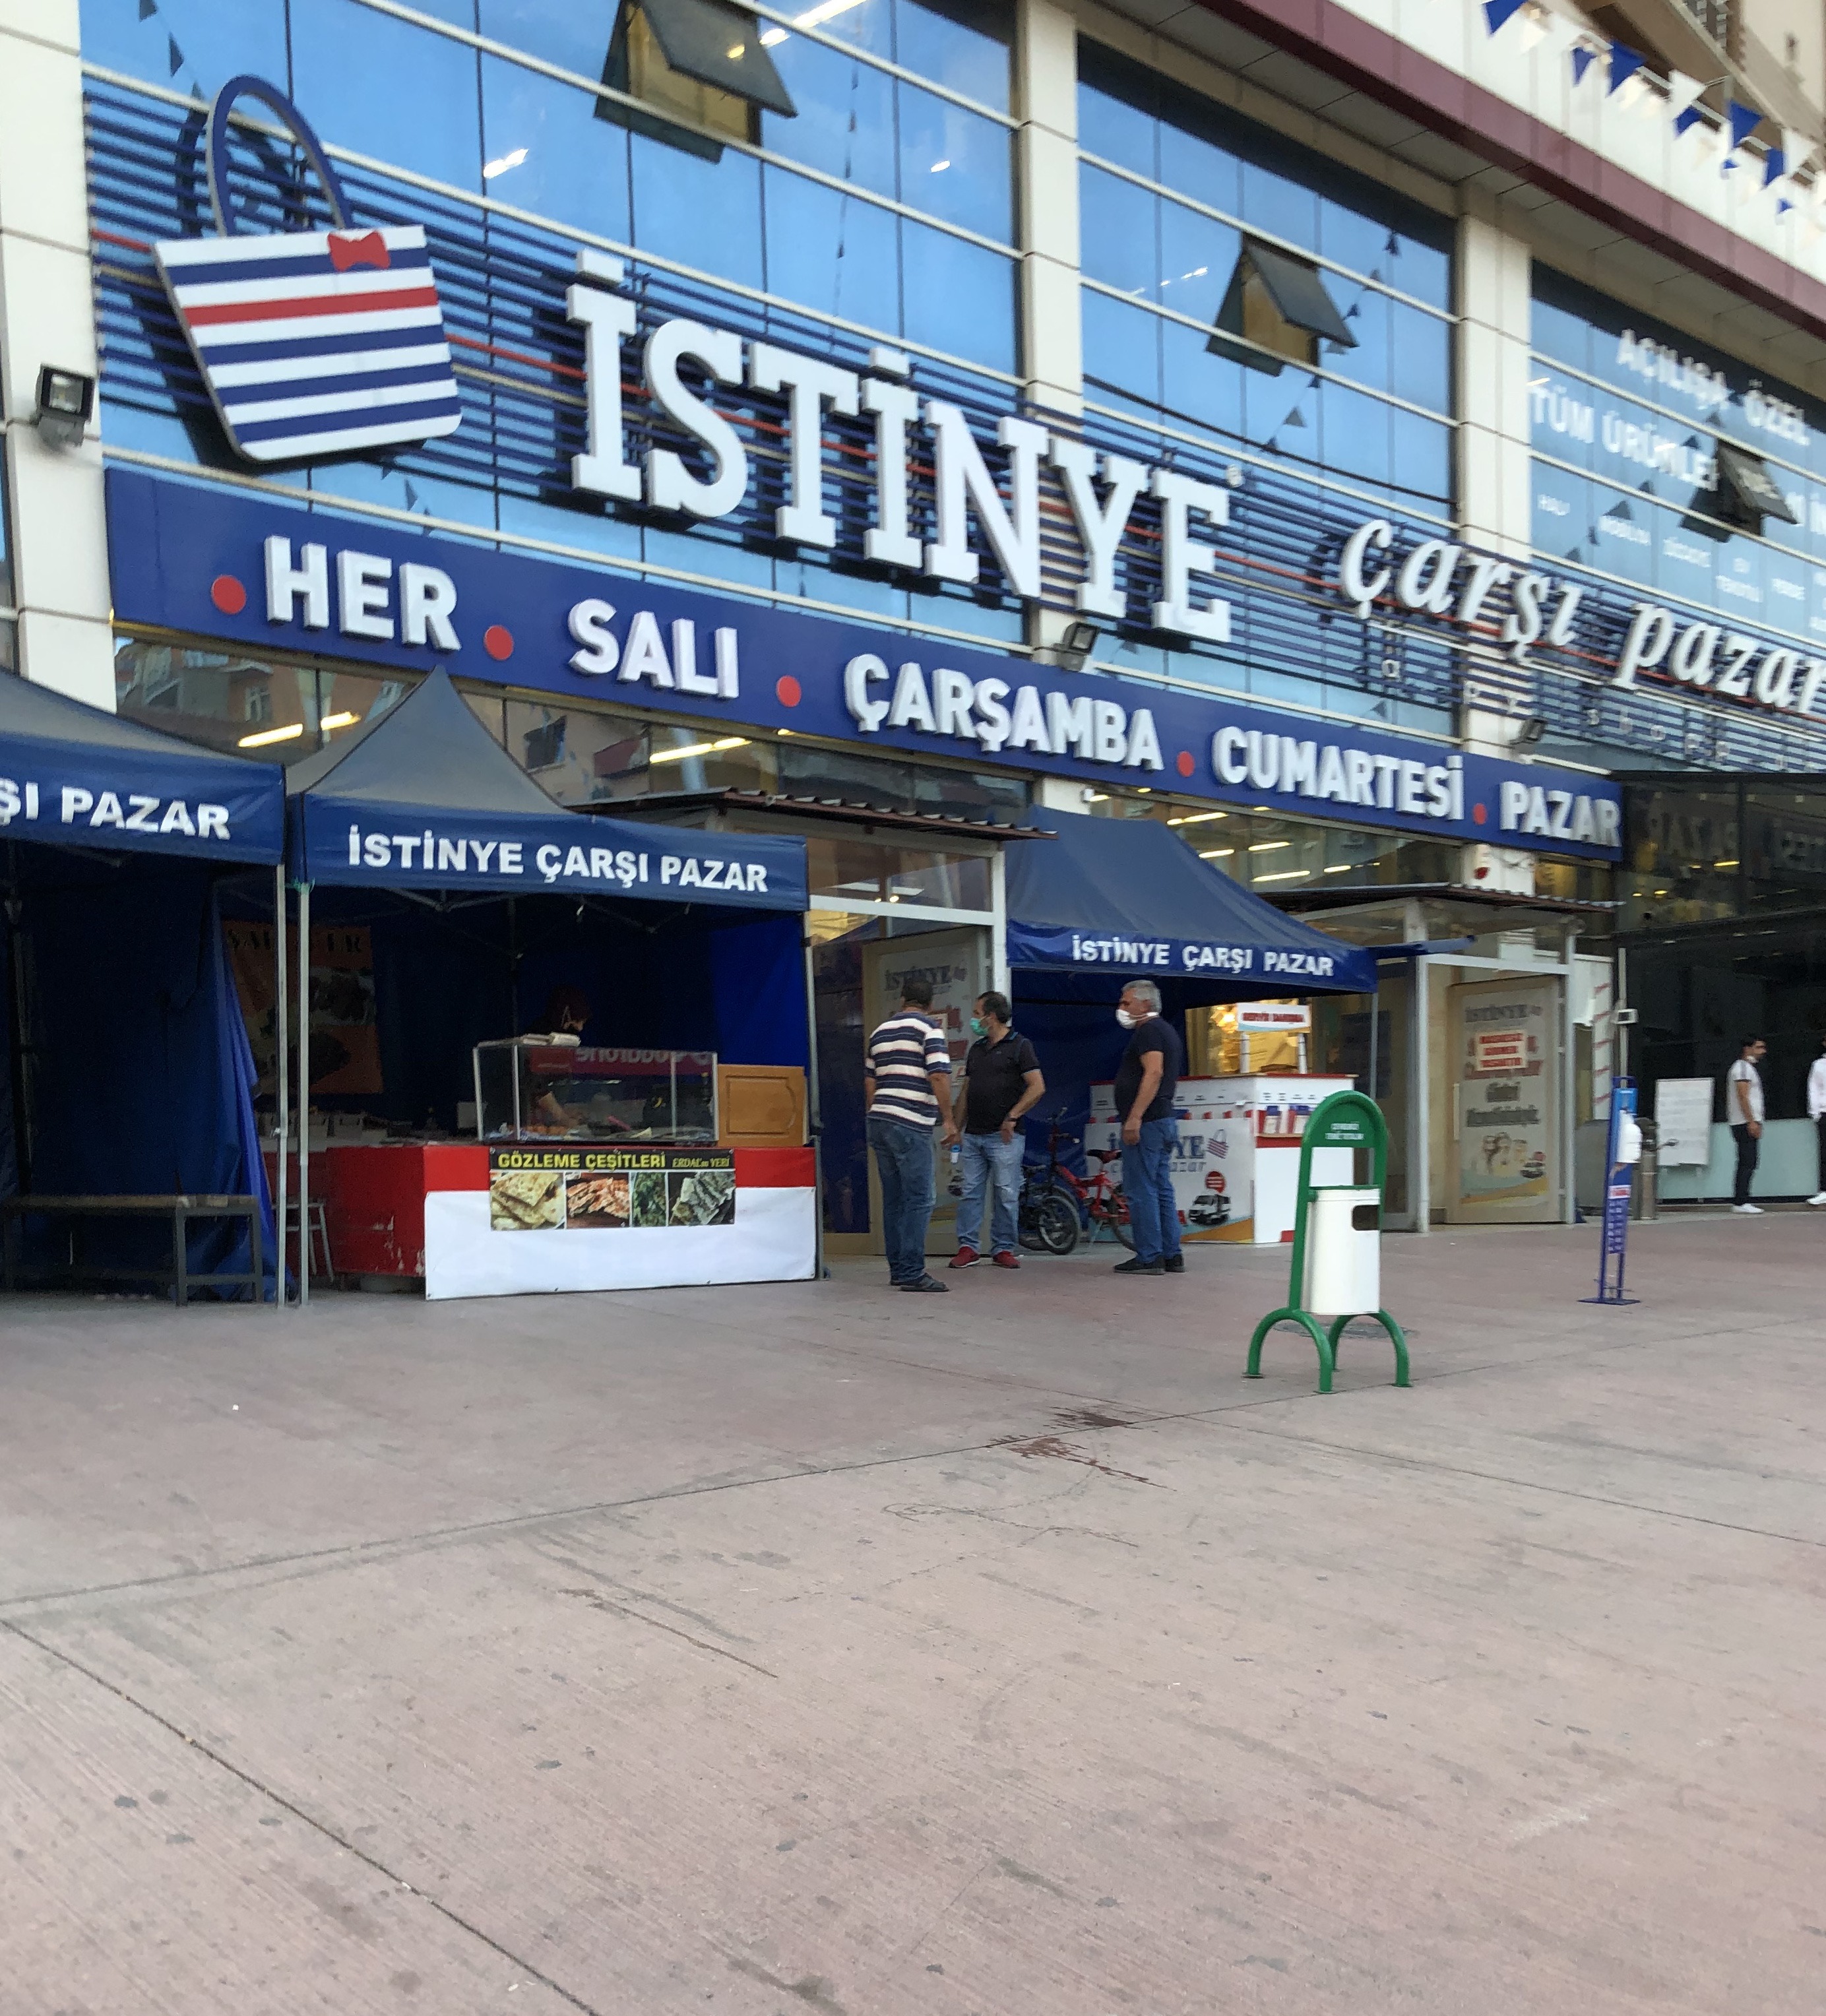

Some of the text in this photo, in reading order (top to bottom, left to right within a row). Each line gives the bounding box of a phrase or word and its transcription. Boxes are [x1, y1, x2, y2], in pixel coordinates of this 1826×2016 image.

[1528, 383, 1595, 445] TÜM
[565, 248, 1826, 714] İSTİNYE çarşı pazar
[265, 535, 462, 652] HER
[567, 597, 740, 699] SALI
[844, 652, 1165, 772] ÇARŞAMBA
[1212, 726, 1464, 821] CUMARTESİ
[1499, 780, 1621, 848] PAZAR
[61, 785, 231, 840] PAZAR
[348, 825, 769, 893] İSTİNYE ÇARŞI PAZAR
[1071, 934, 1335, 977] İSTİNYE ÇARŞI PAZAR
[497, 1150, 581, 1168] GÖZLEME
[585, 1149, 666, 1172] ÇEŞİTLERİ
